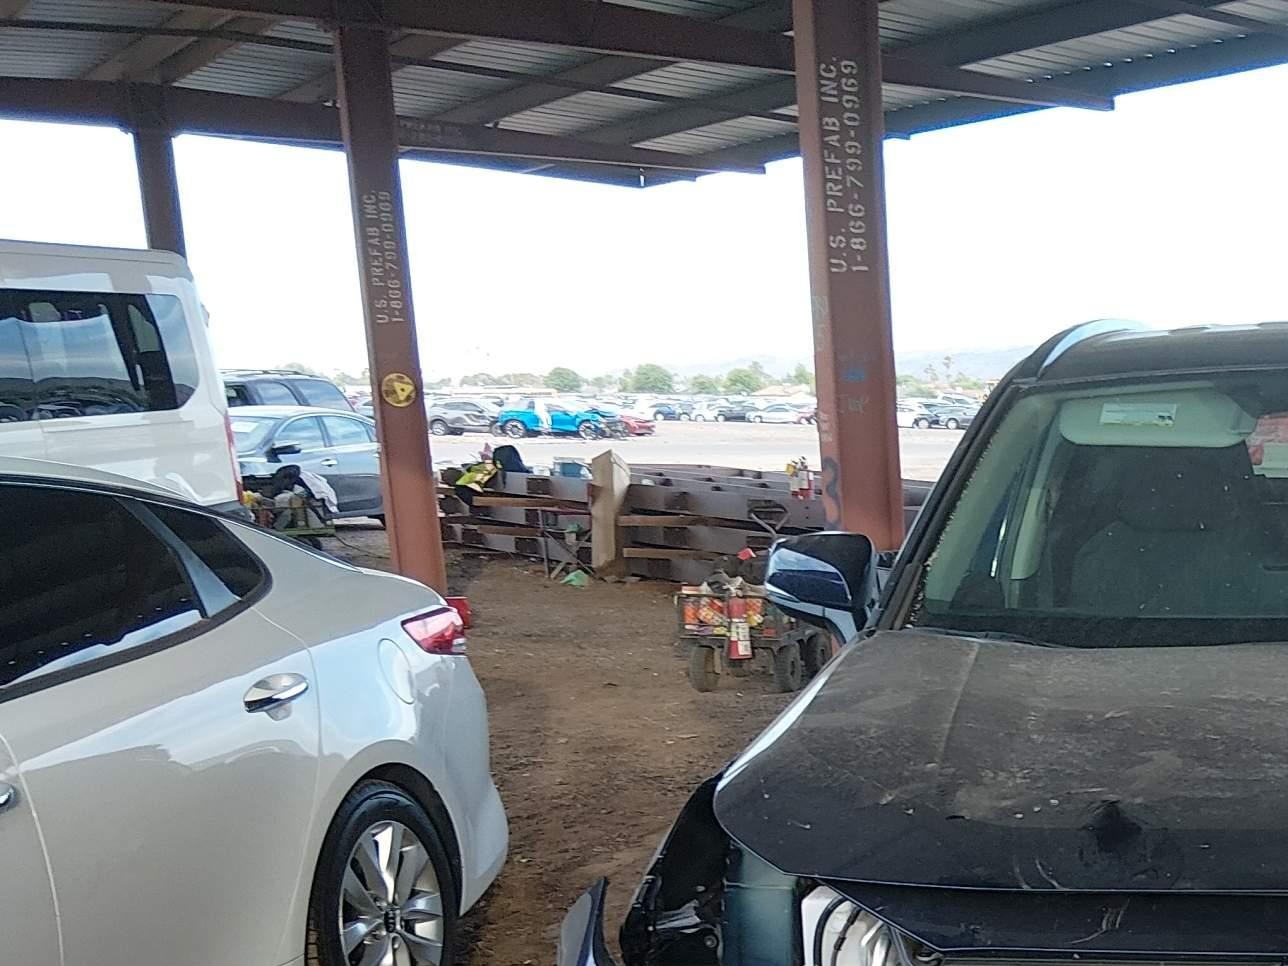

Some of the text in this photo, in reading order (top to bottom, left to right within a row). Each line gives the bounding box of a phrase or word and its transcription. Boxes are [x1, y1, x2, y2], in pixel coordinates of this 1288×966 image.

[366, 226, 385, 287] PREFAB
[819, 56, 847, 273] U.S. PREFAB INC.
[841, 60, 869, 272] 1-866-799-0969
